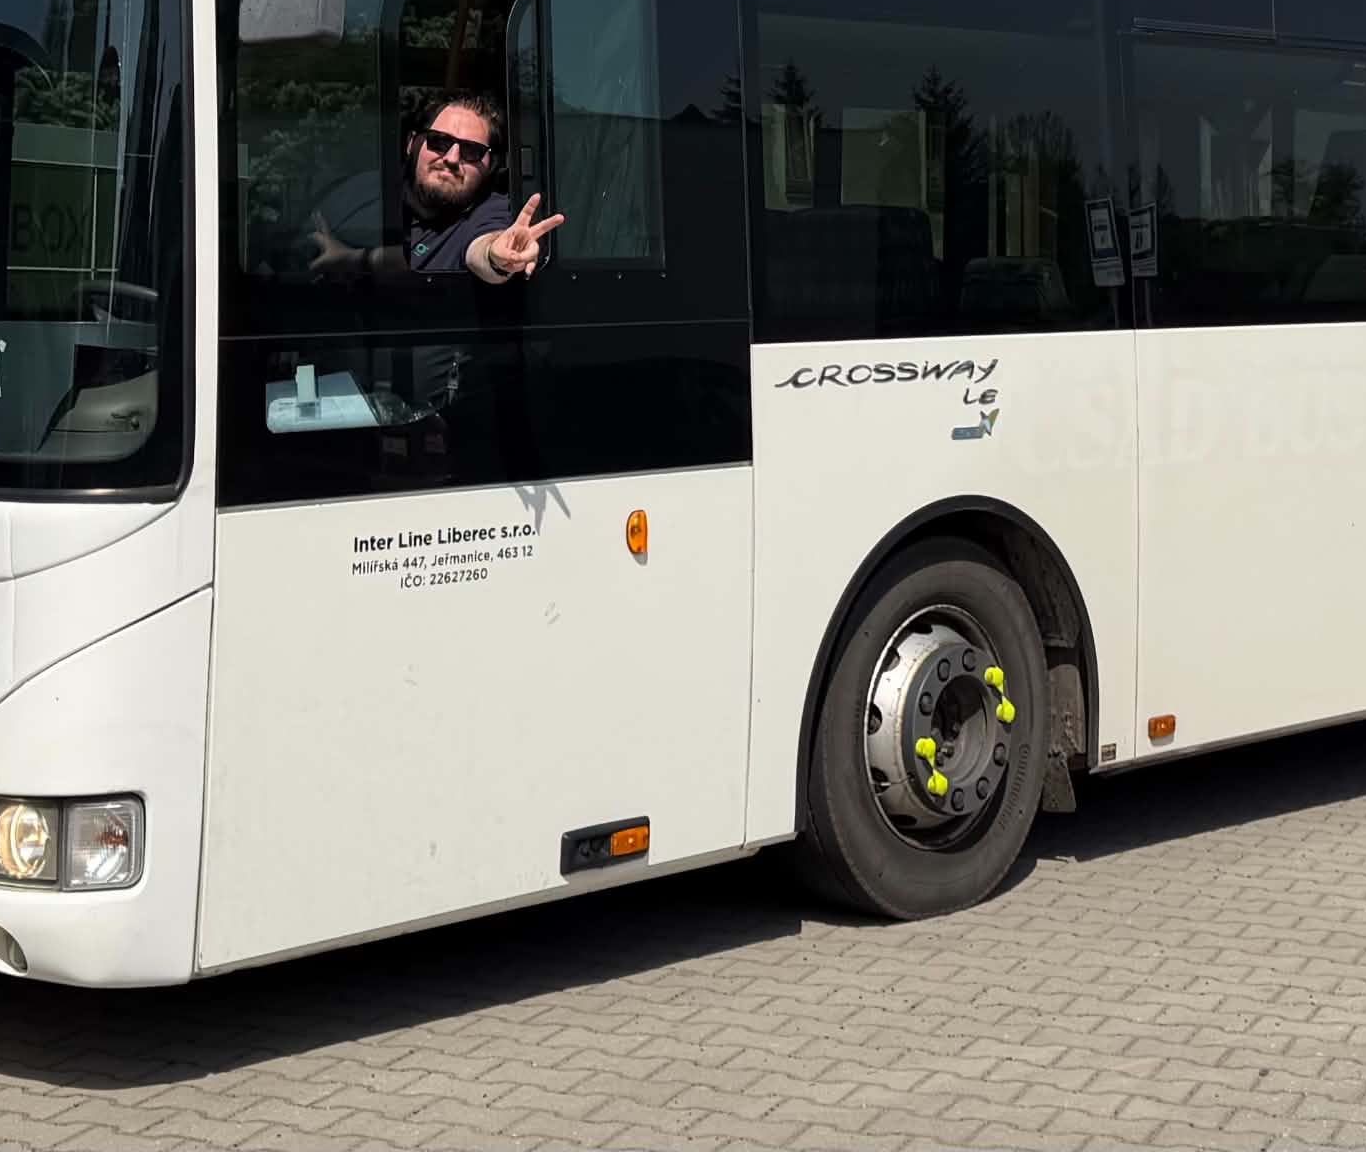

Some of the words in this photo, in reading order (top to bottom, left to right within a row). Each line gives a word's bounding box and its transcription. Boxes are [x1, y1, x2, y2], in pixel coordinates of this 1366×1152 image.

[774, 358, 999, 389] CROSSWAY
[962, 387, 999, 405] LE
[353, 535, 394, 554] Inter
[398, 530, 433, 549] Line
[437, 526, 496, 545] Liberec
[501, 523, 537, 539] s.r.o.
[402, 556, 428, 571] 447,
[430, 550, 494, 568] Jeřmanice,
[497, 546, 519, 561] 463
[400, 574, 426, 589] IČO:
[429, 567, 489, 586] 22627260
